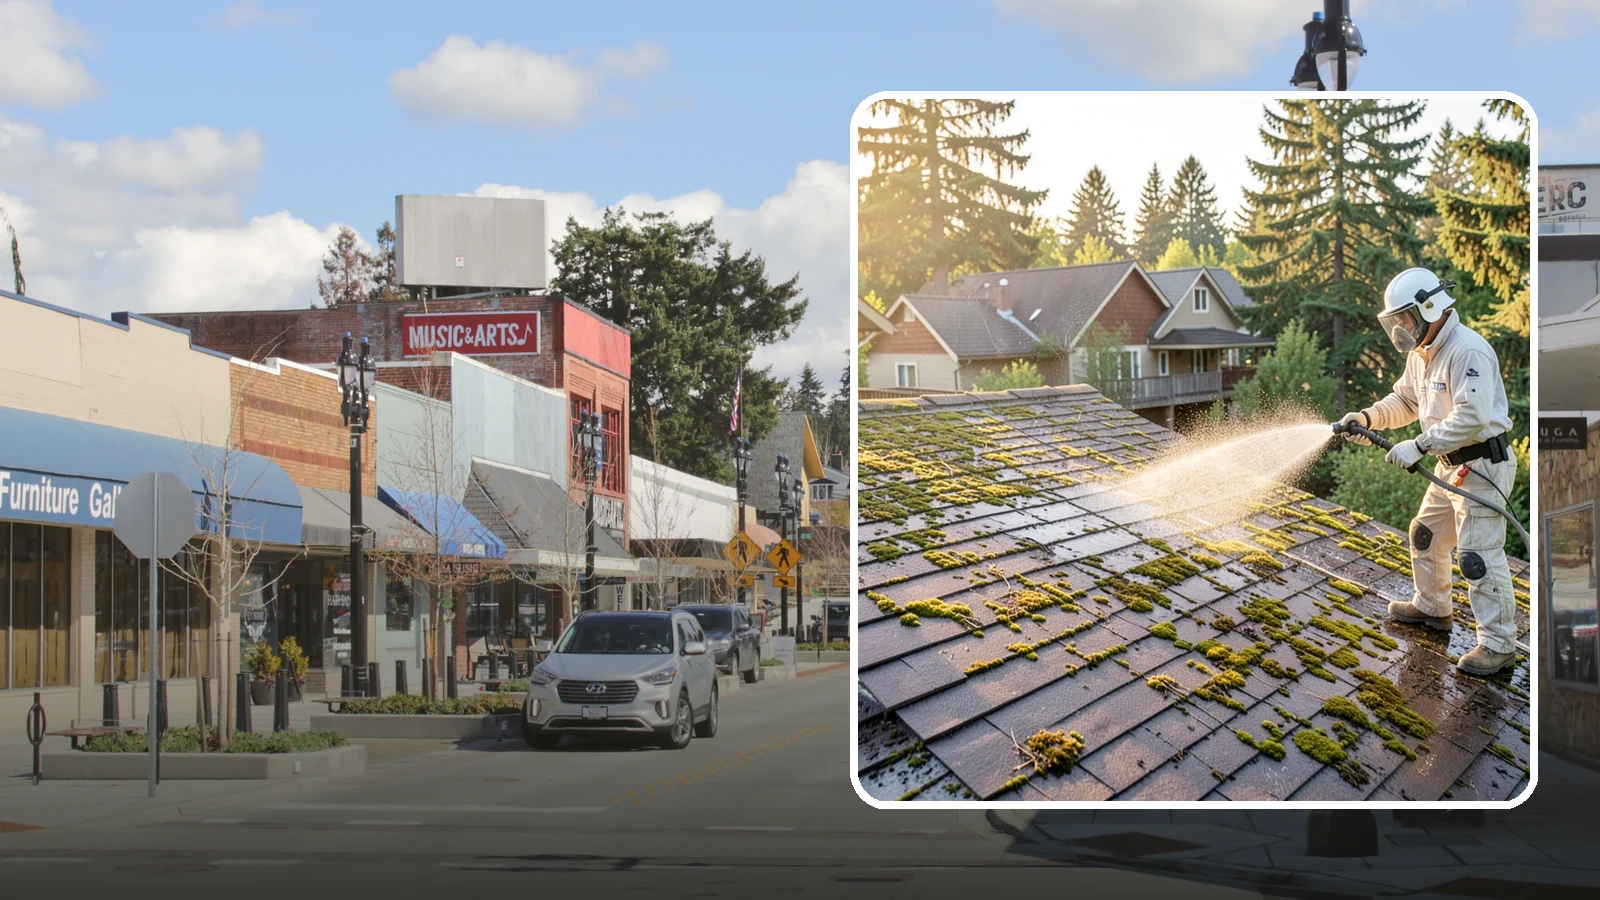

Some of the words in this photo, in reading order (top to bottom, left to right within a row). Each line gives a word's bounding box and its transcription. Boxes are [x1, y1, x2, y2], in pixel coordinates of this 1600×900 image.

[0, 471, 79, 515] Furniture
[89, 482, 122, 519] Gal
[453, 563, 479, 574] SUSHI
